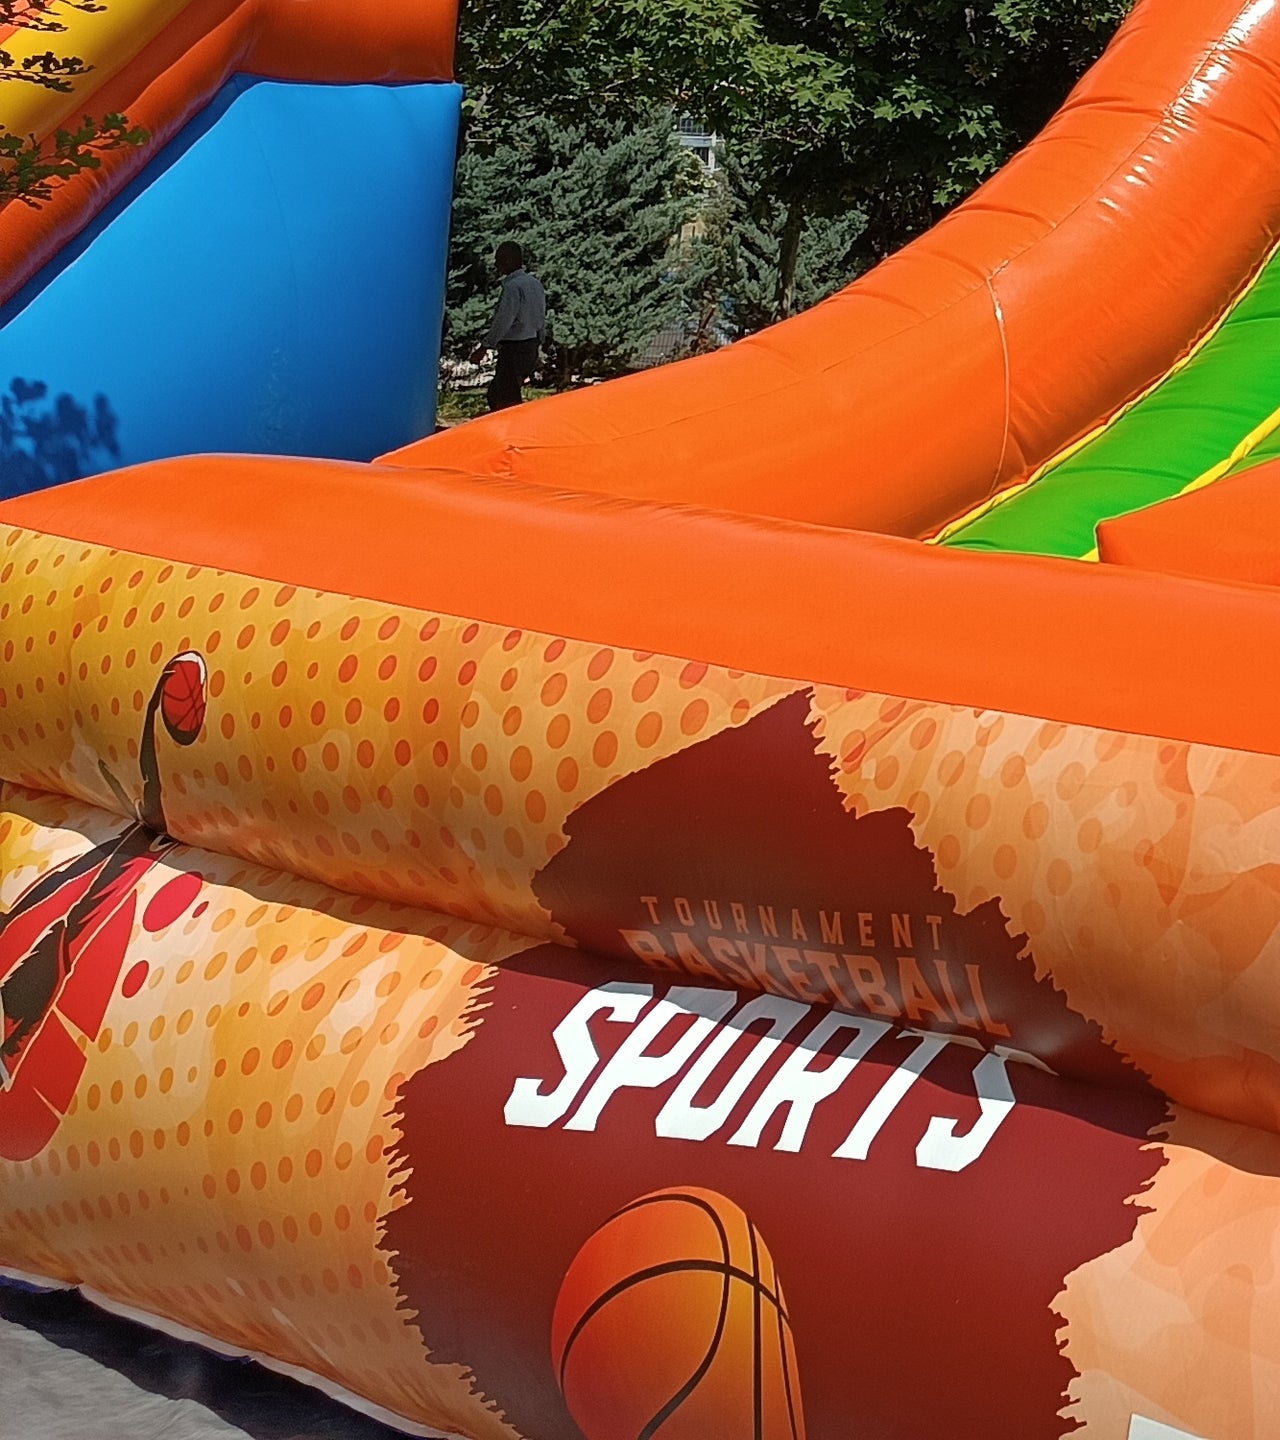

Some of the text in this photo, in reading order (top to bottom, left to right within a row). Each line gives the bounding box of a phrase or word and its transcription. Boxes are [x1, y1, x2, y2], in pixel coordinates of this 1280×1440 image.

[640, 896, 943, 951] TOURNAMENT
[618, 928, 1012, 1038] BASKETBALL
[503, 980, 1059, 1173] SPORTS
